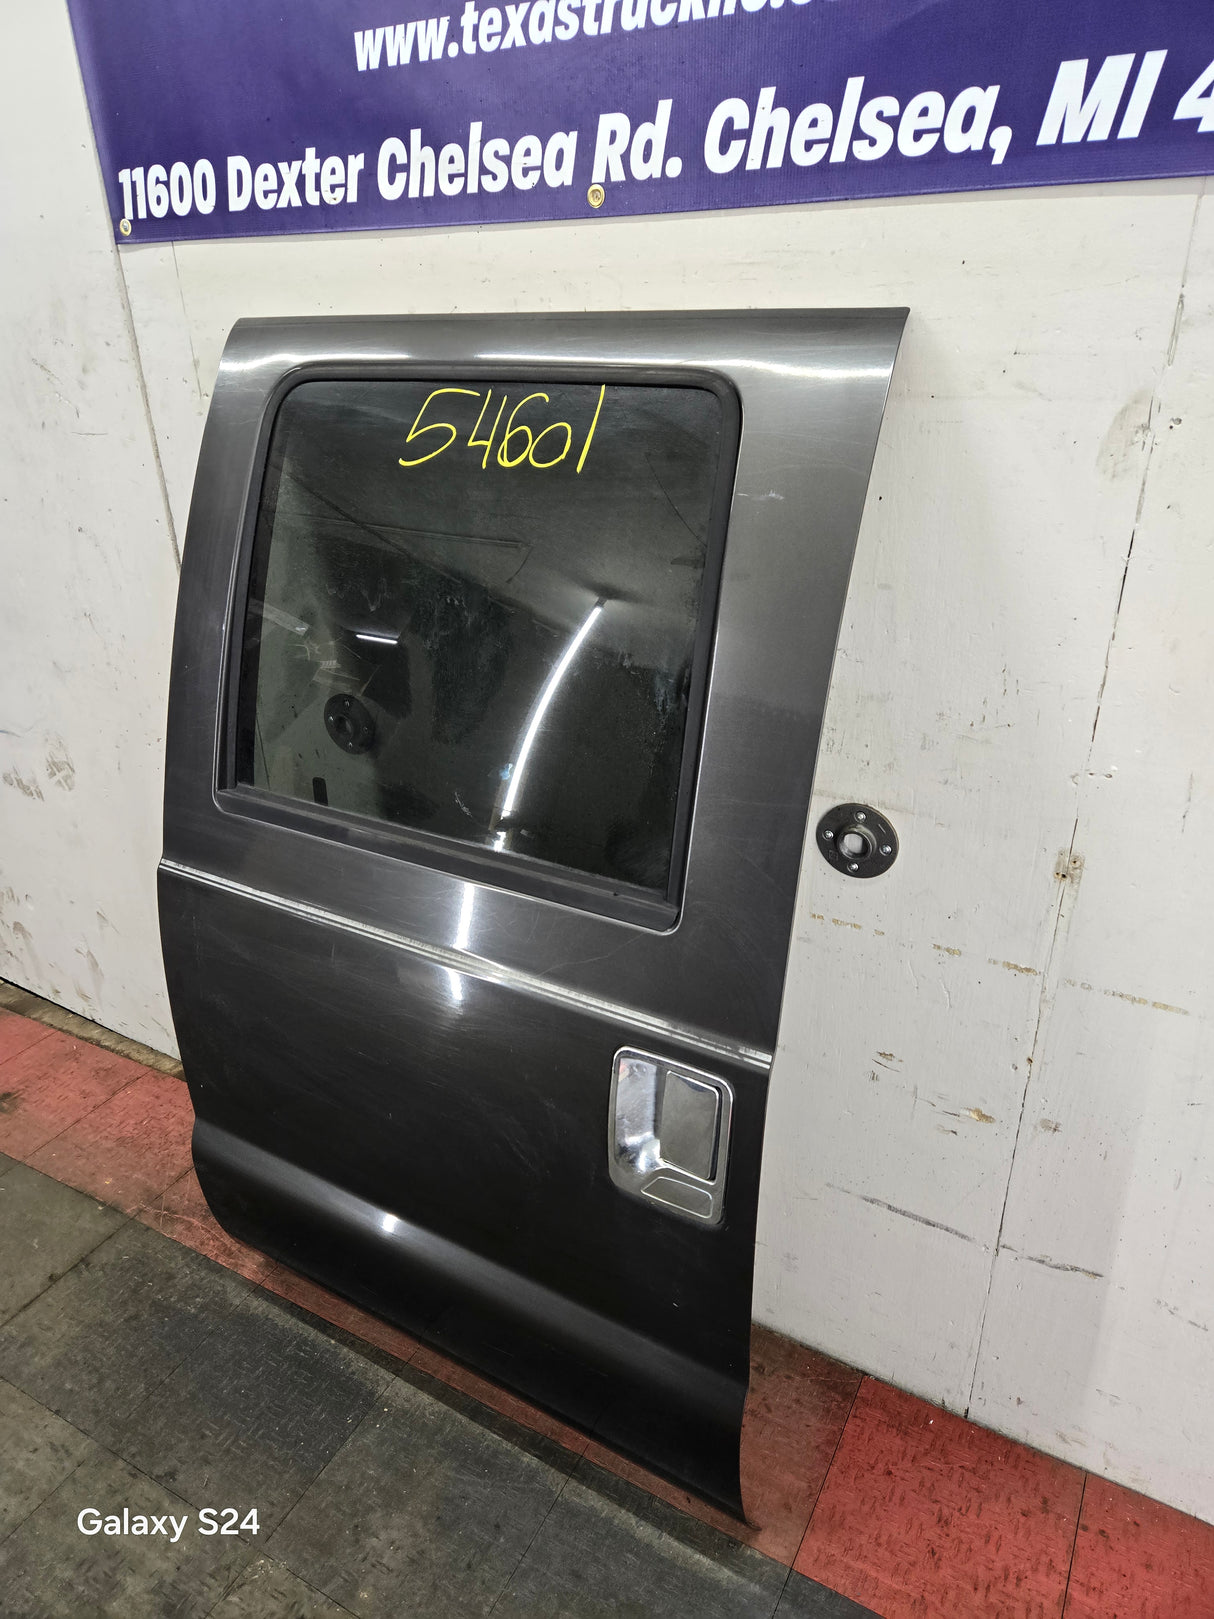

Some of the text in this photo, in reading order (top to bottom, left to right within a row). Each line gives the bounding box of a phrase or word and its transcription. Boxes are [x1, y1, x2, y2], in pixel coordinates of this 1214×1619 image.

[118, 158, 217, 220] 11600
[227, 146, 365, 212] Dexter
[377, 120, 578, 201] Chelsea
[591, 98, 683, 184] Rd.
[703, 75, 1013, 175] Chelsea,
[1036, 49, 1168, 146] MI
[398, 383, 606, 474] 54601
